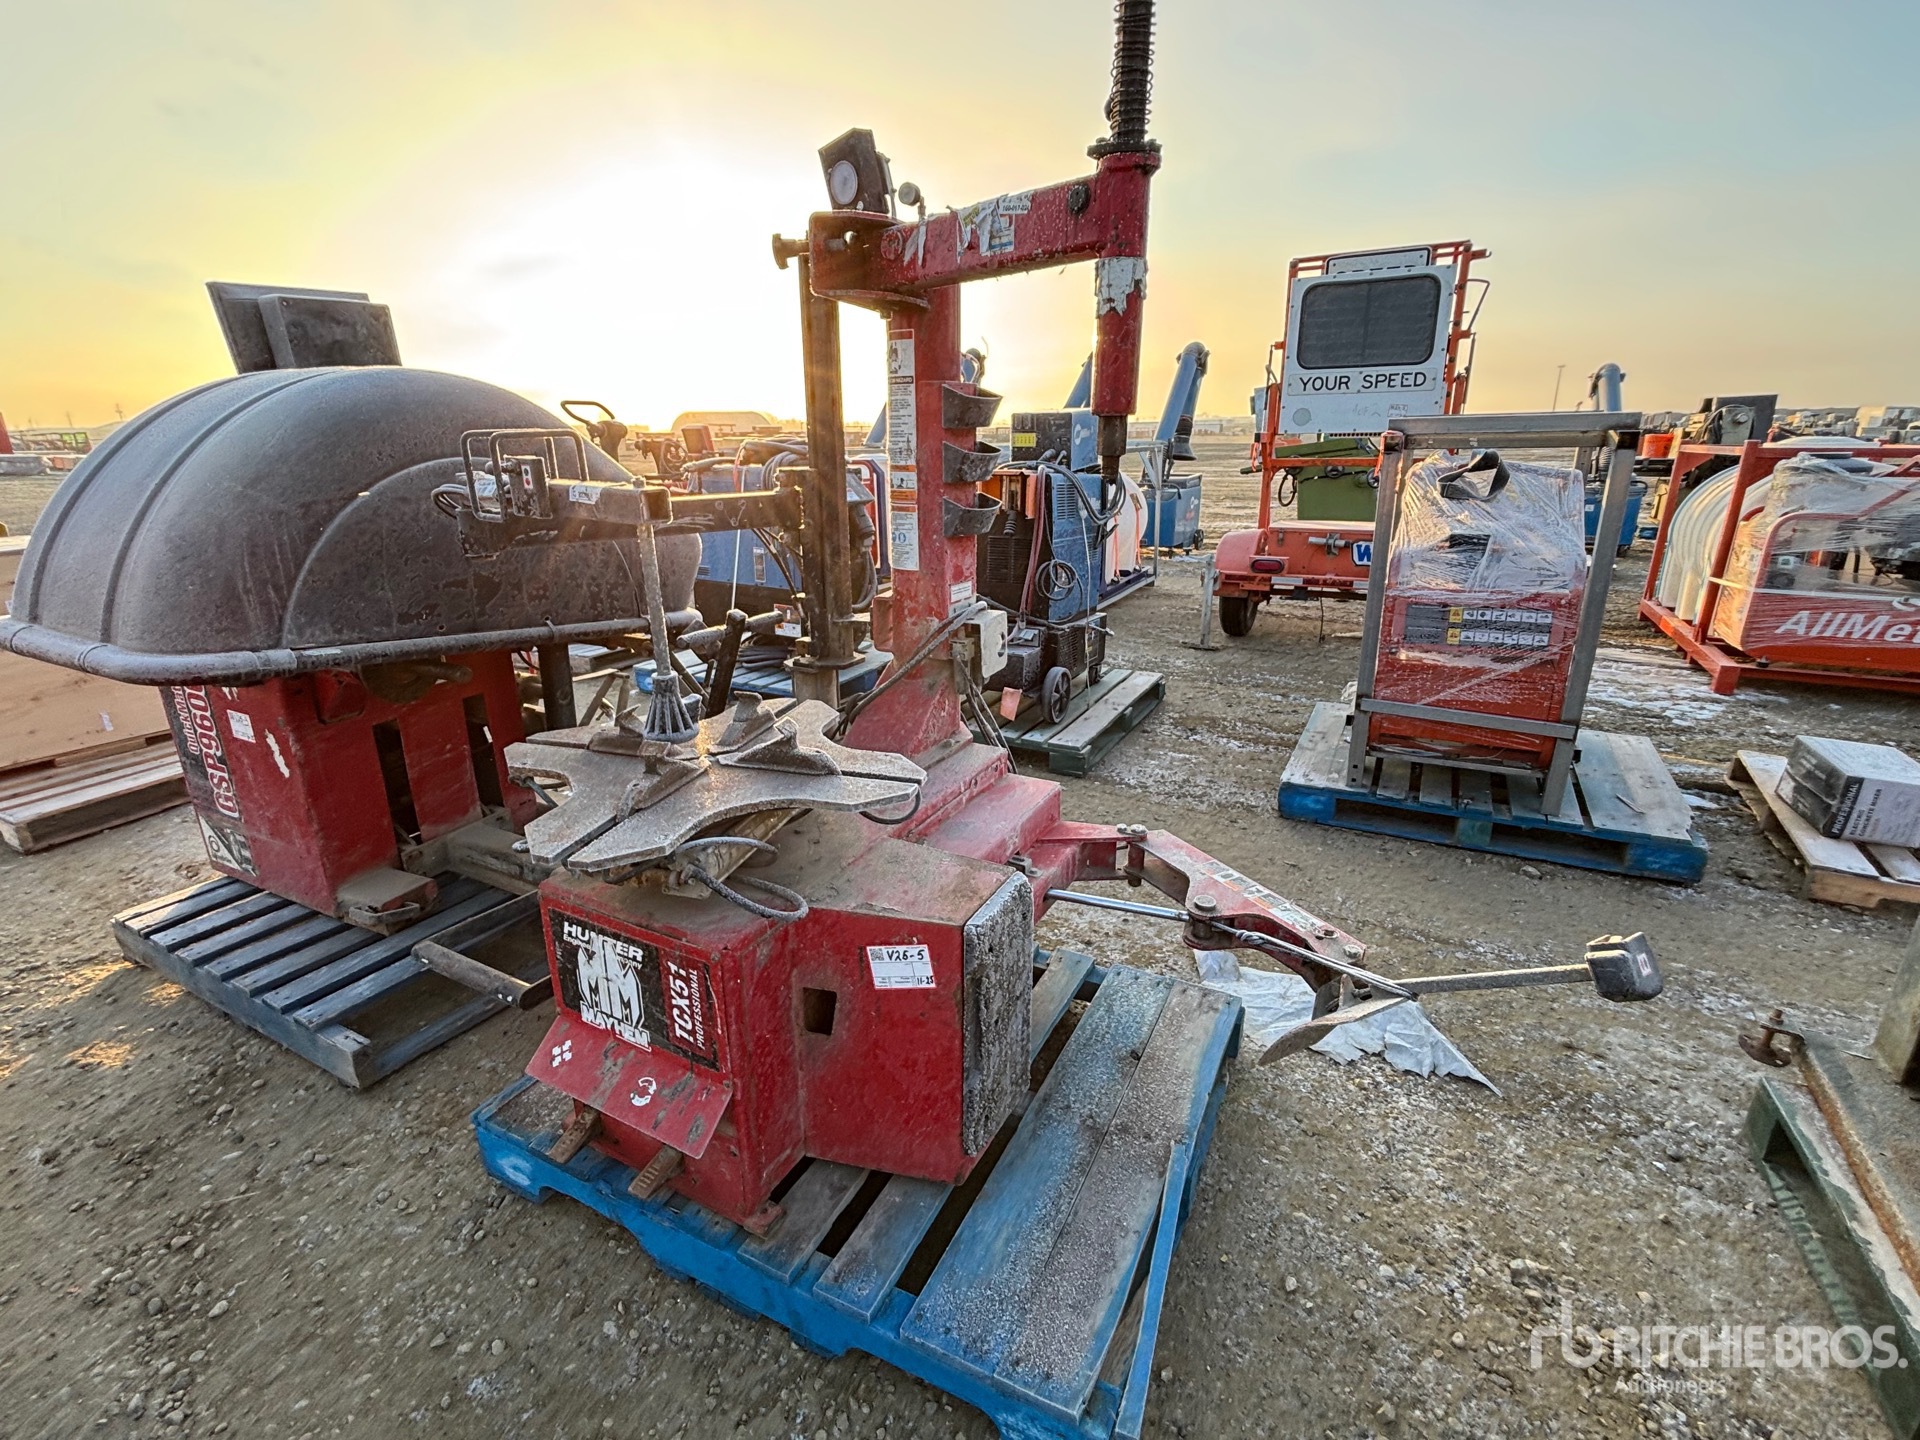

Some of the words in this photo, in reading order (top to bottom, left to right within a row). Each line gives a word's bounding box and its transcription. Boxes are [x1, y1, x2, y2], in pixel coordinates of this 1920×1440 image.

[1299, 375, 1351, 392] YOUR
[1361, 371, 1427, 389] SPEED
[1831, 783, 1859, 835] PROFESSIONAL
[564, 921, 643, 962] HUNTER
[580, 1001, 651, 1052] MAYHEM
[667, 961, 695, 1044] TCX51
[688, 968, 706, 1050] PROFESSIONAL
